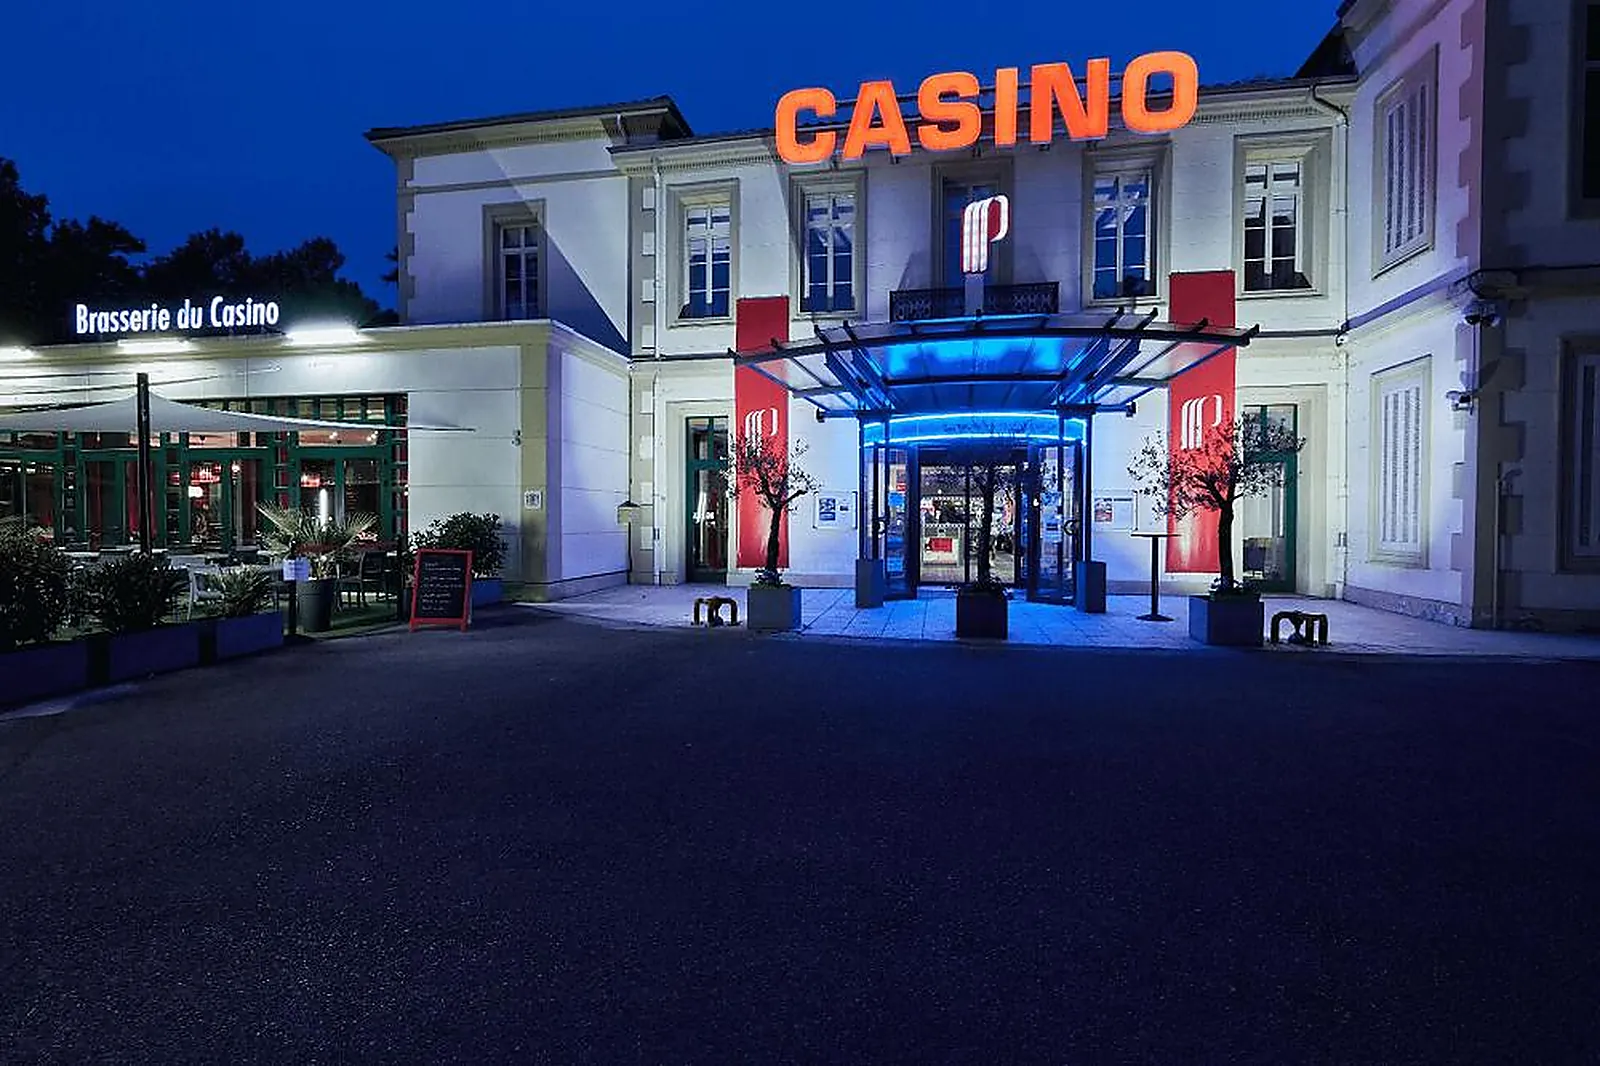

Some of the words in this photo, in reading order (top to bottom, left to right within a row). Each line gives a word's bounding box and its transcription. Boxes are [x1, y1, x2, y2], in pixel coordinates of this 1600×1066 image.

[775, 51, 1198, 164] CASINO
[76, 303, 170, 334] Brasserie
[177, 299, 203, 330] du
[210, 296, 280, 328] Casino
